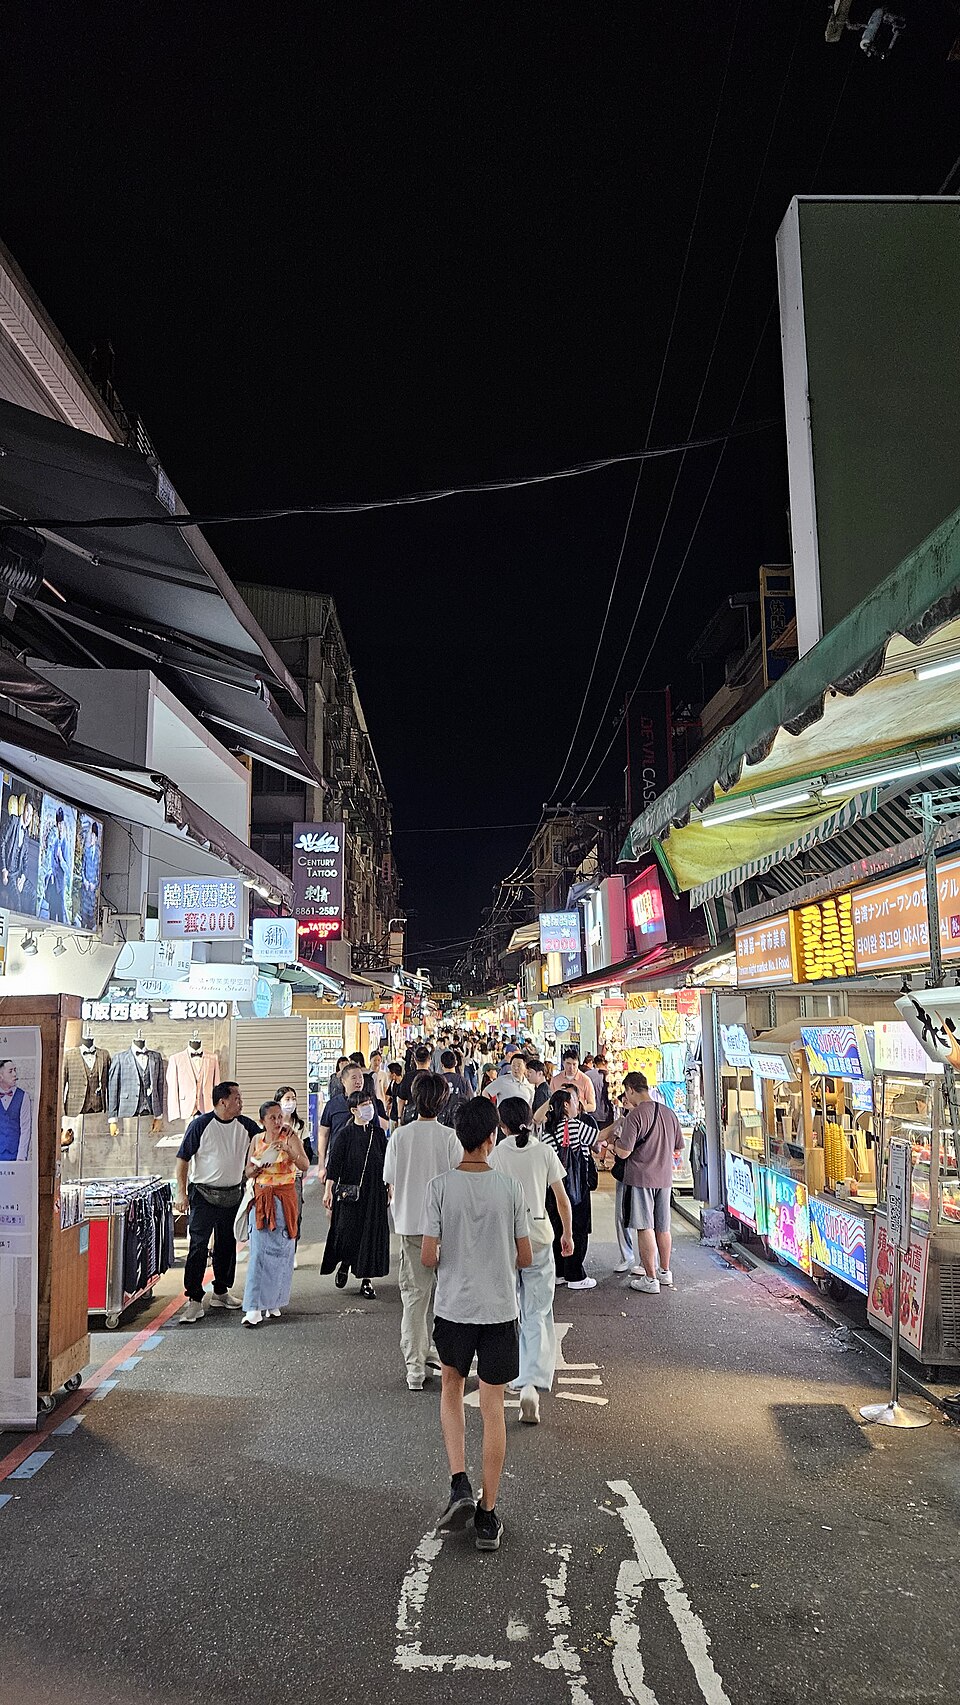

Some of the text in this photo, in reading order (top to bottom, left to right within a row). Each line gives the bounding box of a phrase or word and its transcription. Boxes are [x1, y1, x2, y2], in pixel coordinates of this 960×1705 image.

[297, 856, 336, 867] CENTURY
[306, 867, 338, 878] TATTOO
[304, 884, 331, 903] 刺青
[295, 906, 340, 916] 8861-2587
[308, 922, 340, 931] TATTOO
[545, 938, 577, 951] 2000
[857, 933, 878, 956] 타이완
[879, 927, 902, 952] 최고의
[903, 921, 929, 948] 야시장
[778, 954, 790, 970] Food
[817, 1032, 844, 1055] SUPER
[825, 1211, 851, 1251] SUPER
